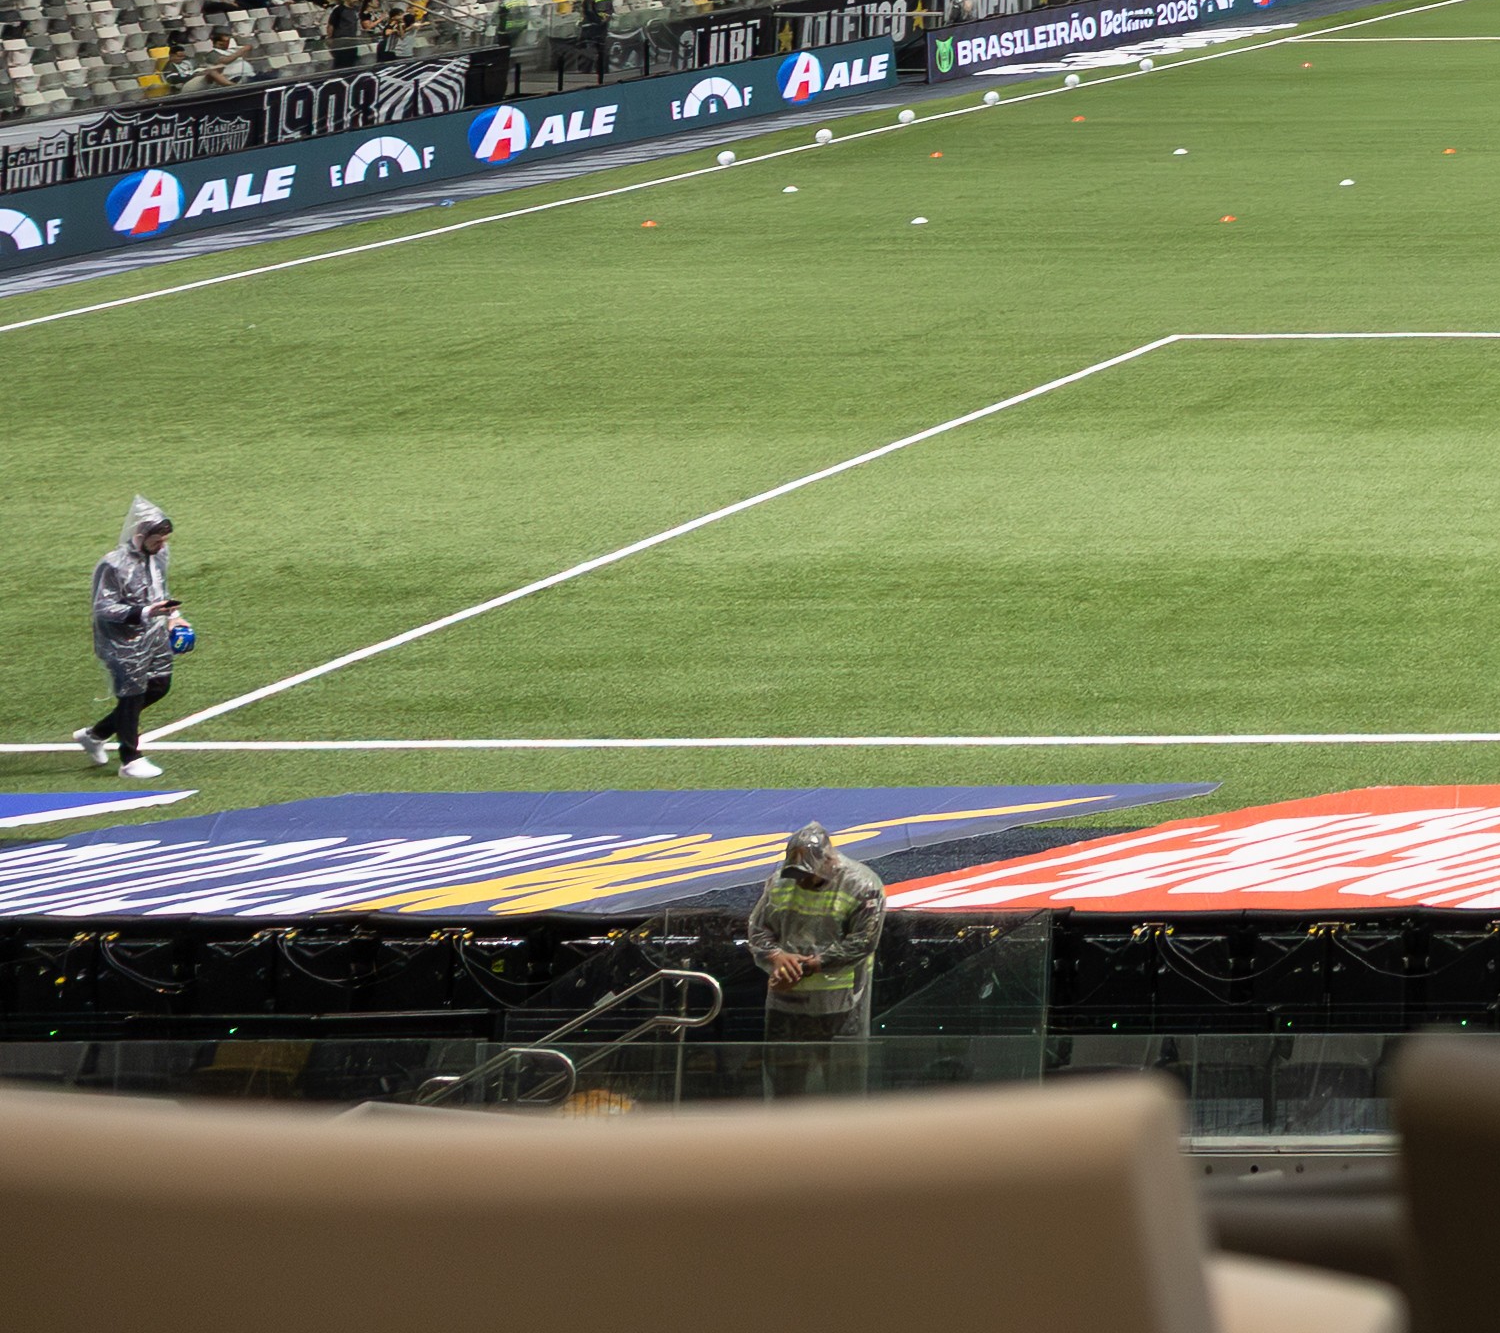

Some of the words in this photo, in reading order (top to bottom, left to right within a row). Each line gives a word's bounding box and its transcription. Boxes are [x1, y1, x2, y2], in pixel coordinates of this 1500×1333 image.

[956, 5, 1097, 67] BRASILEIRÃO
[823, 52, 890, 93] ALE
[264, 71, 380, 145] 1908
[530, 103, 619, 149] ALE
[86, 125, 130, 147] CAM
[184, 164, 297, 219] ALE
